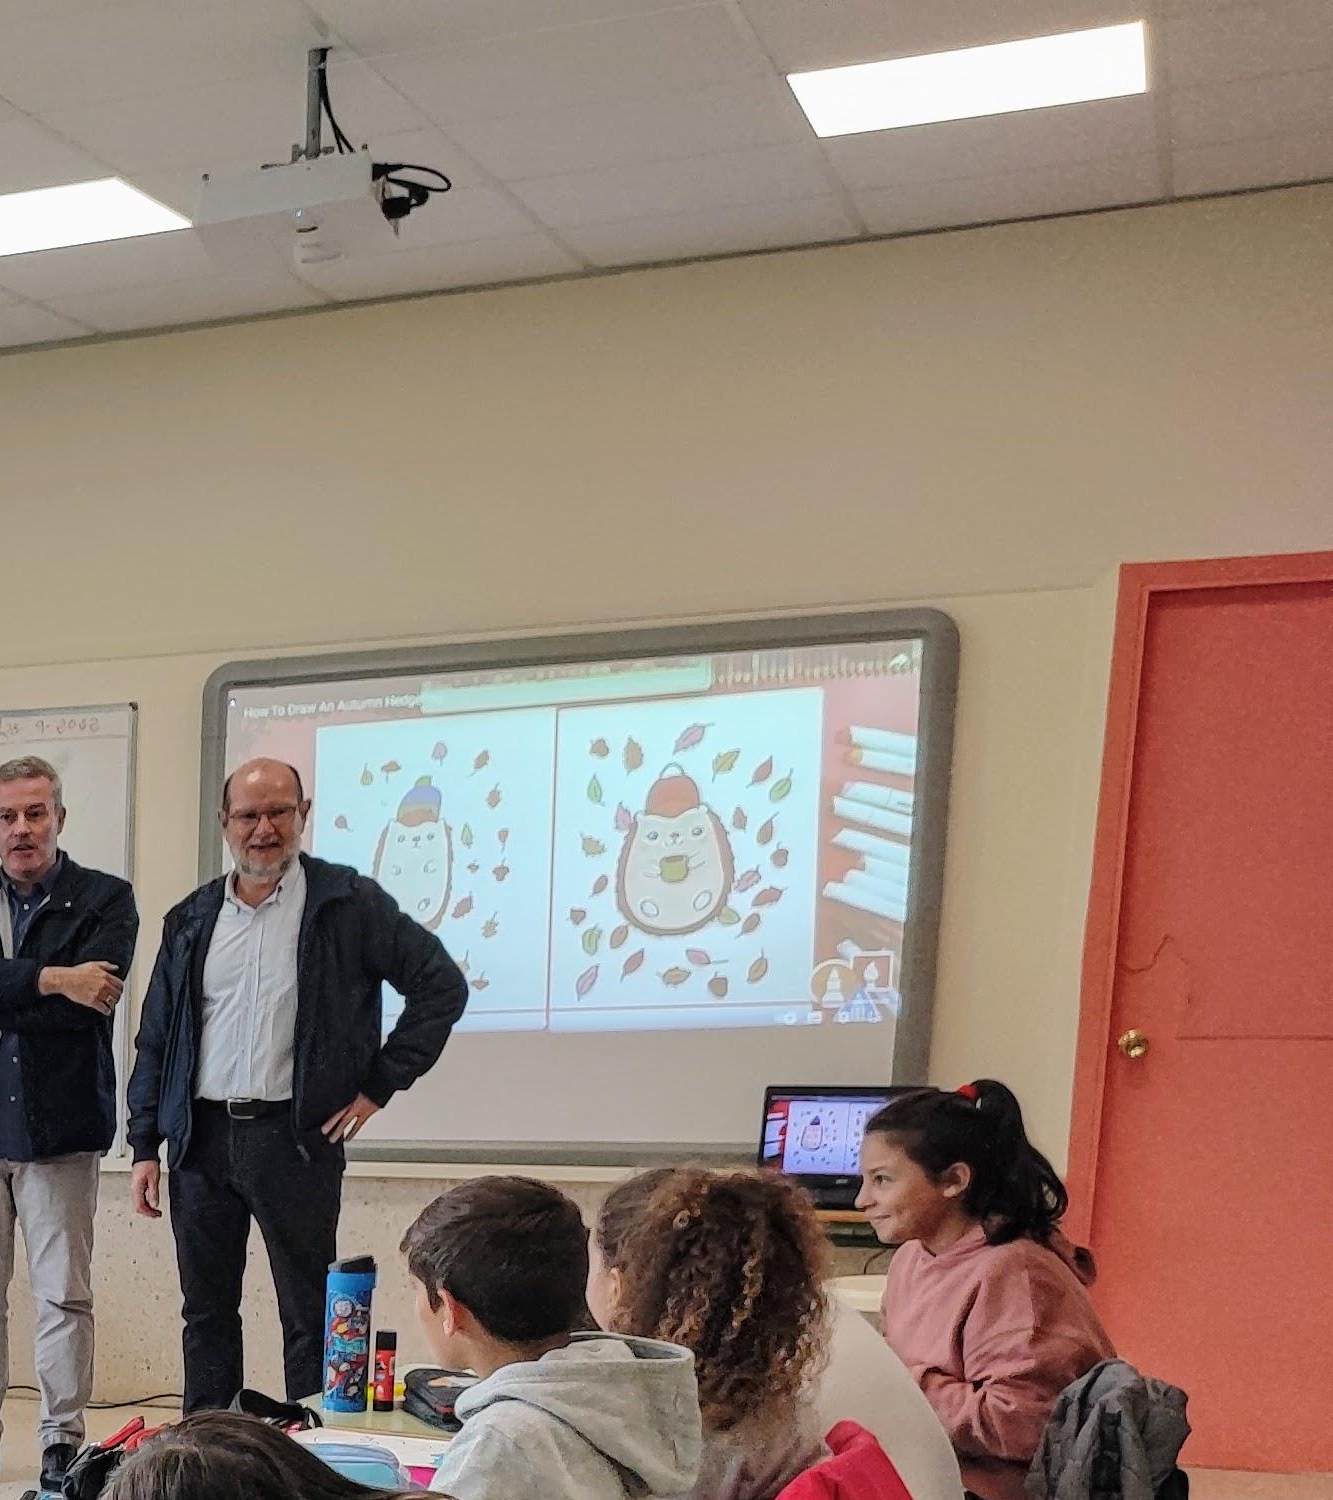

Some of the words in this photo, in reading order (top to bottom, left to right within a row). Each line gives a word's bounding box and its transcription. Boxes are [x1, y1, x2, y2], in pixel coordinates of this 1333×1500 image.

[243, 706, 270, 719] How
[271, 704, 285, 717] To
[286, 702, 317, 716] Draw
[318, 700, 334, 713] An
[337, 696, 383, 712] Autumn
